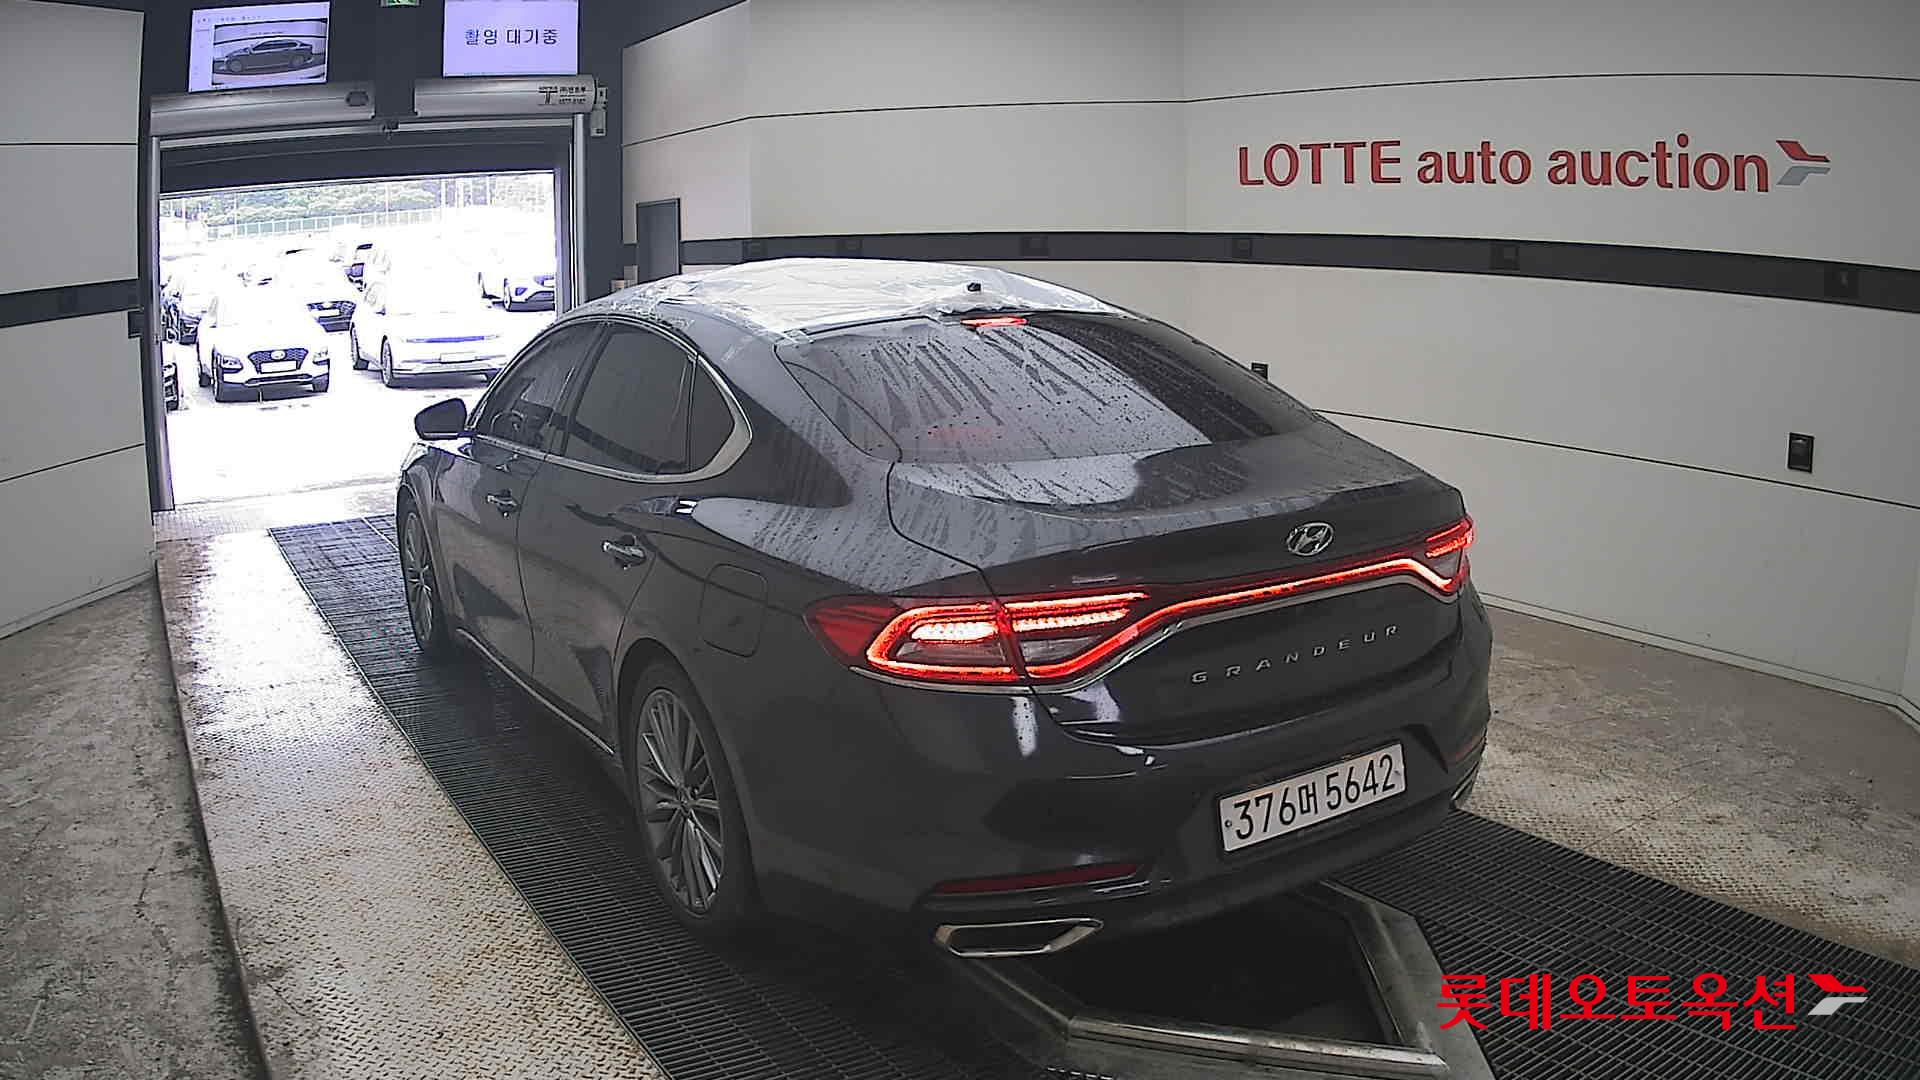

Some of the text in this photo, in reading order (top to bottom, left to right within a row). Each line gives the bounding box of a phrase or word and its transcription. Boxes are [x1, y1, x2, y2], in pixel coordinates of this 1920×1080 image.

[465, 29, 558, 46] 촬영 대기중
[1239, 133, 1769, 193] LOTTE auto auction
[1191, 624, 1398, 683] GRANDEUR
